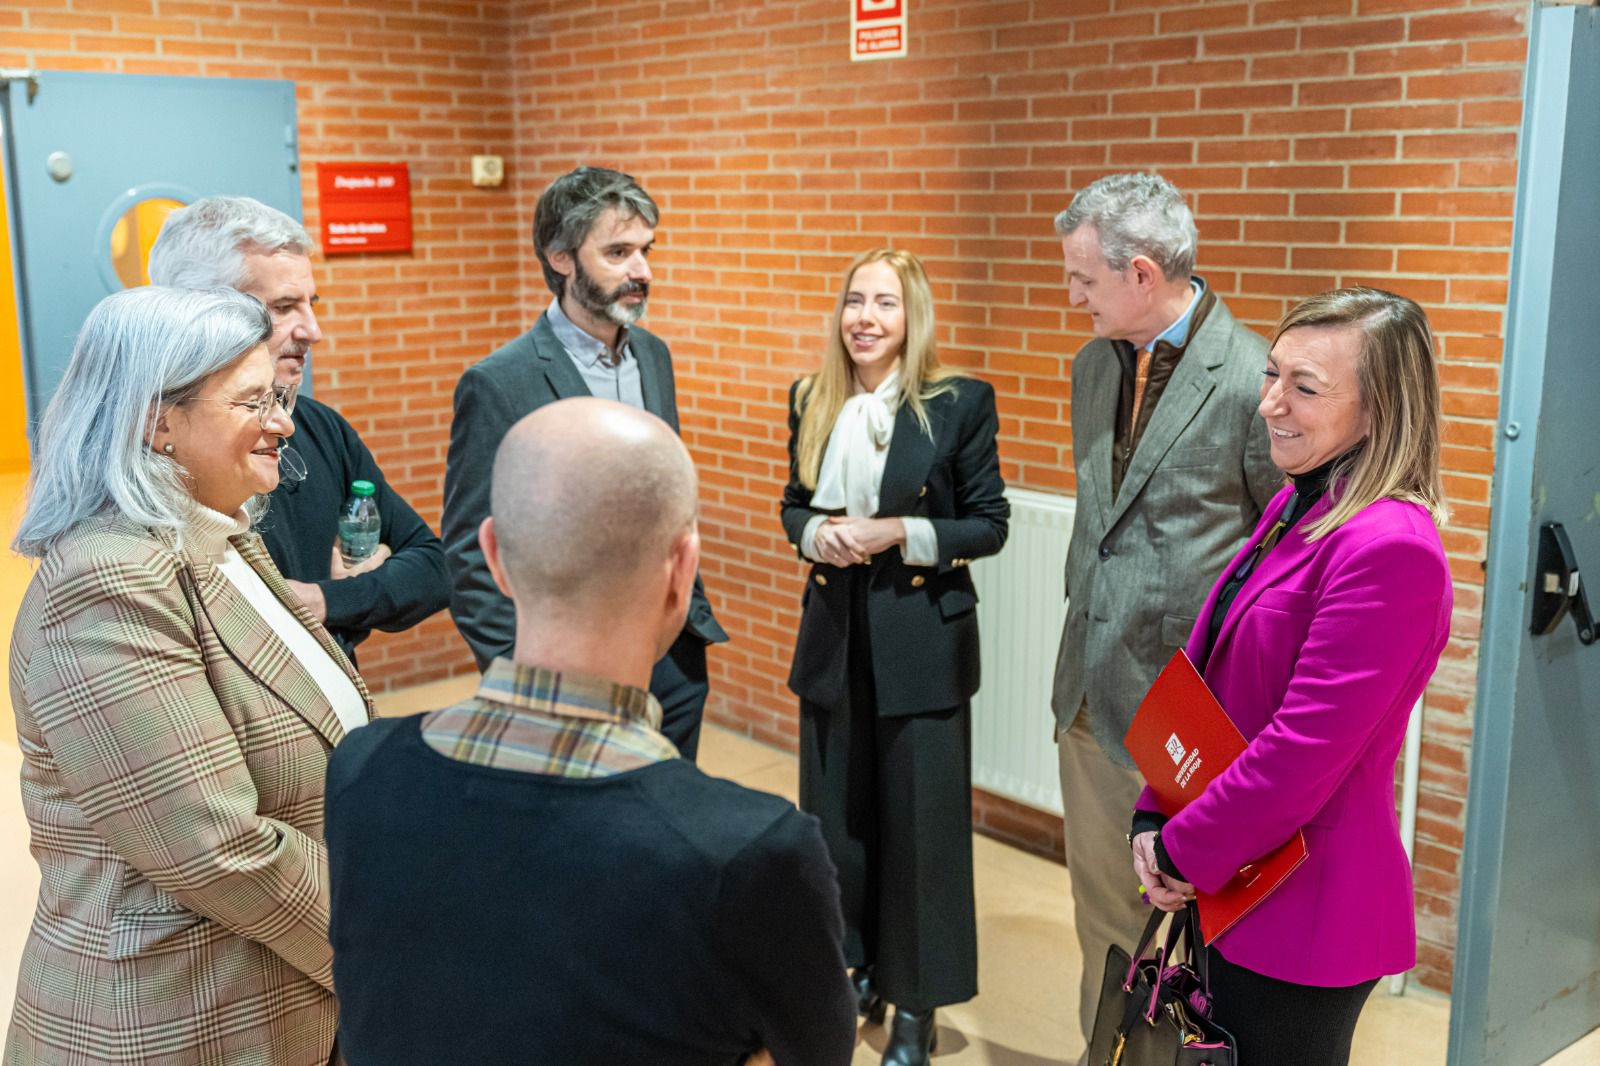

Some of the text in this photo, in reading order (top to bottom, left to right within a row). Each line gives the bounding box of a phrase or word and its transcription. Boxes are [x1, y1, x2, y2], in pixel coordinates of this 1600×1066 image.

[1175, 748, 1199, 784] UNIVERSIDAD
[1180, 778, 1187, 789] DE
[1189, 757, 1202, 774] RIOJA
